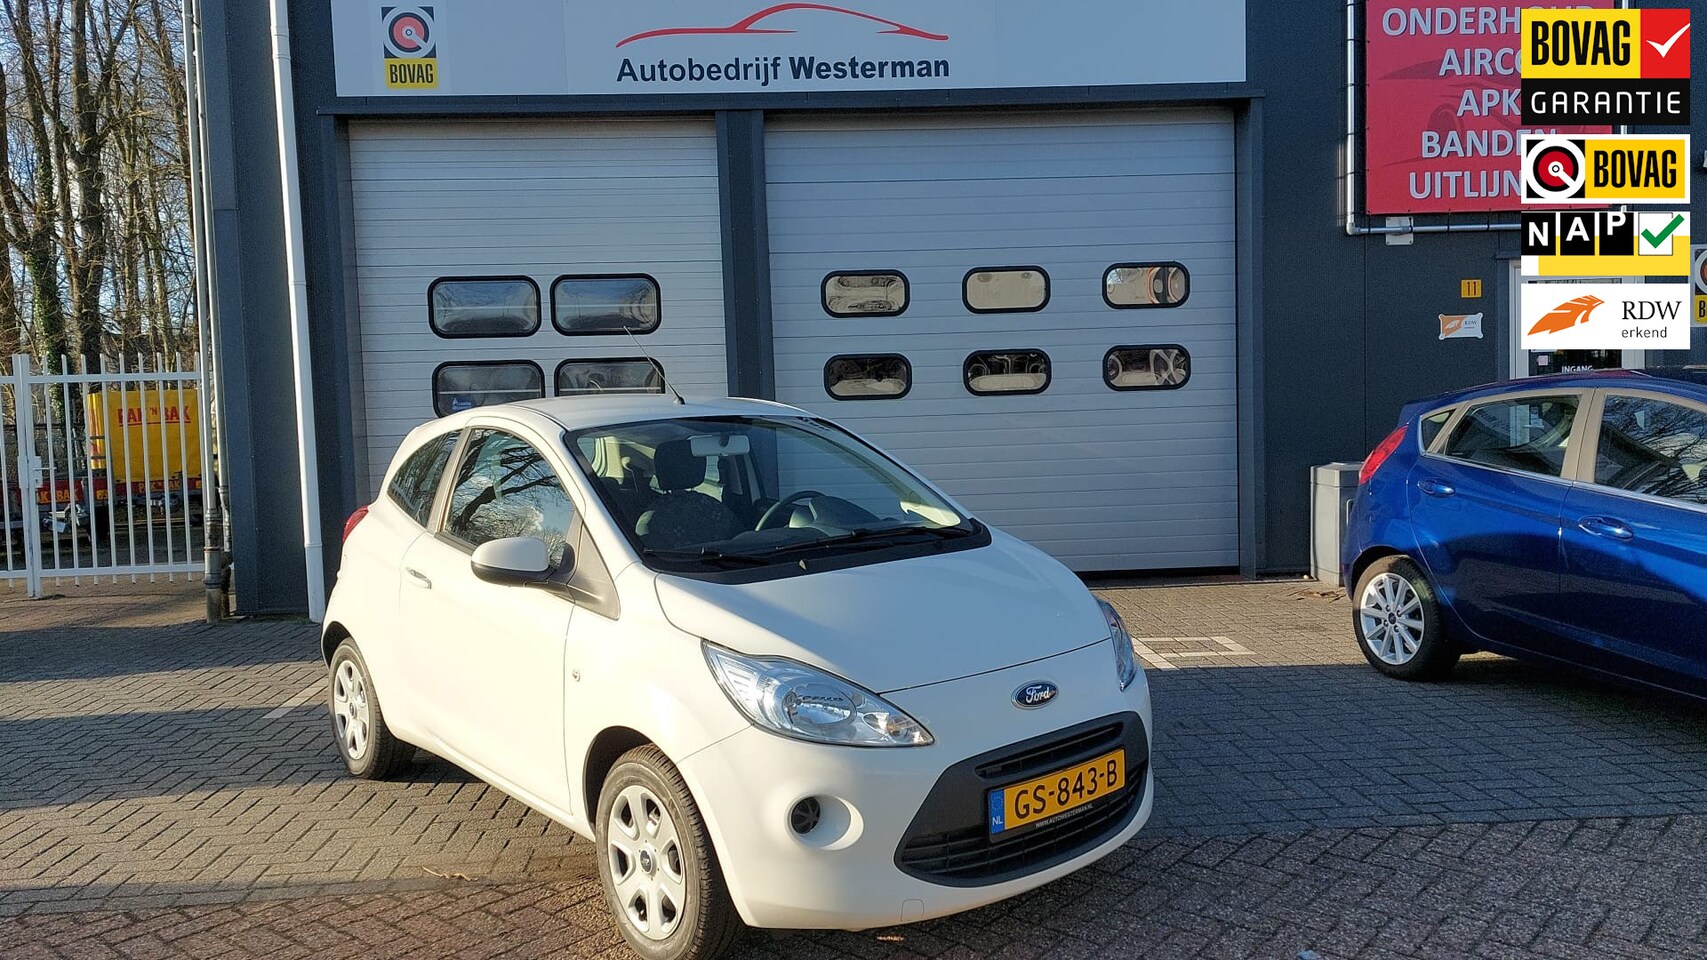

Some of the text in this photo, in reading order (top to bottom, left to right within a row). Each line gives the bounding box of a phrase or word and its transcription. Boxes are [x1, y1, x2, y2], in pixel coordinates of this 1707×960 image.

[1382, 6, 1594, 36] ONDERH
[389, 63, 434, 84] BOVAG
[616, 55, 950, 87] Autobedrijf Westerman
[1439, 47, 1521, 76] AIRC
[1457, 88, 1521, 117] APK
[1422, 128, 1556, 158] BAND
[1409, 170, 1521, 199] UITLIJN
[1466, 281, 1477, 297] 11
[1025, 685, 1051, 704] Ford
[1014, 759, 1117, 819] GS-843-B
[992, 816, 1003, 826] NL
